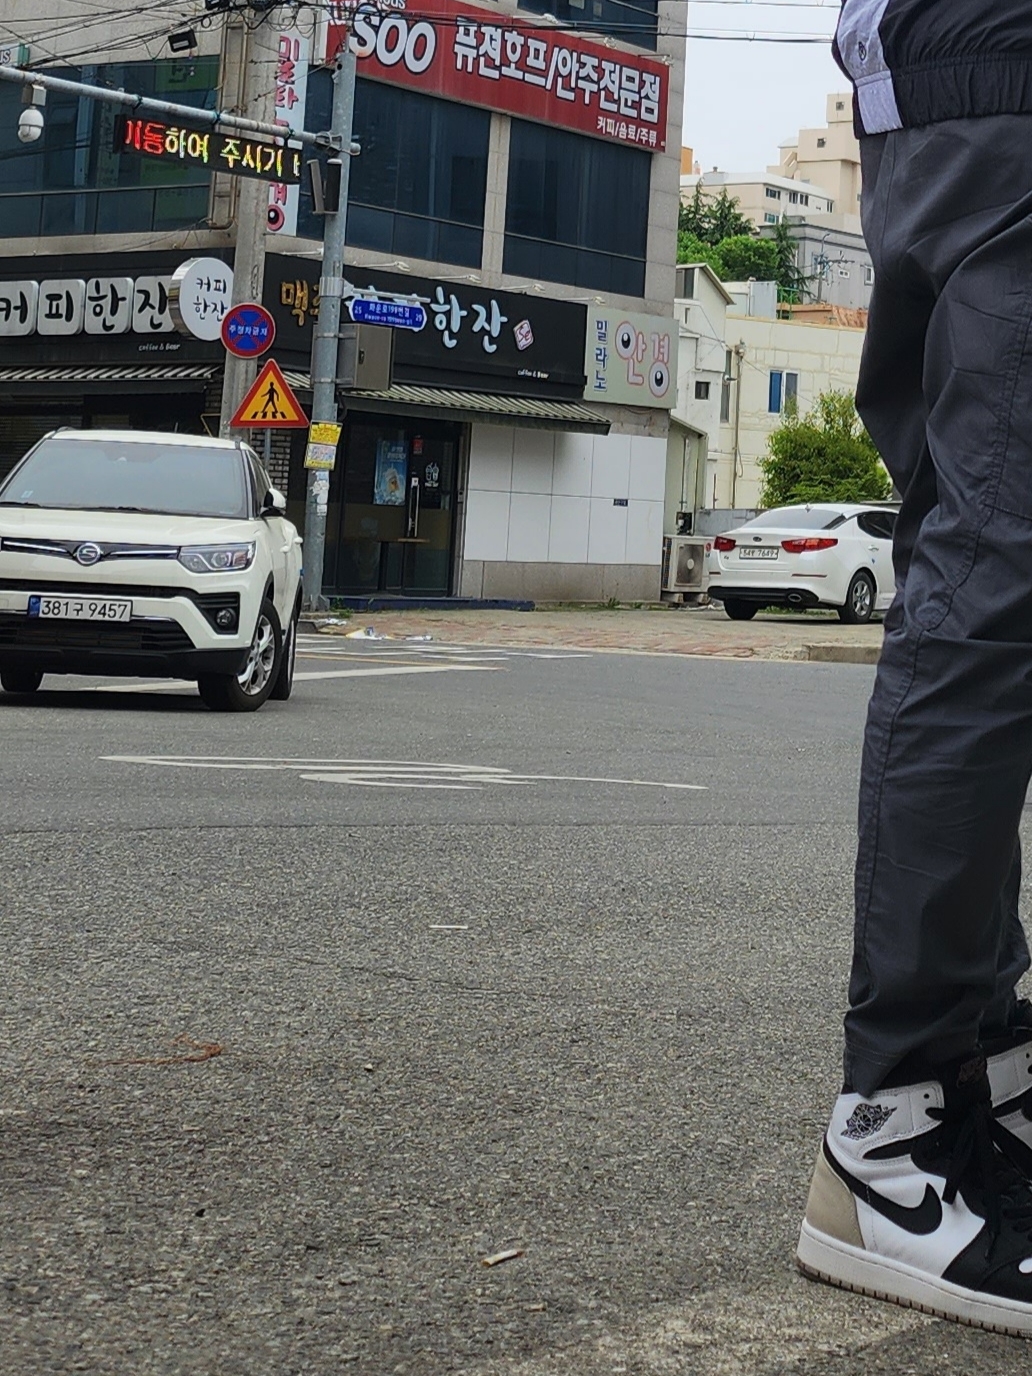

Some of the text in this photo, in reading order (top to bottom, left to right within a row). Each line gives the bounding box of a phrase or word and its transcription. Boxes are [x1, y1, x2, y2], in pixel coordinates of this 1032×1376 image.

[349, 2, 437, 74] SOO
[597, 115, 658, 147] 커피/음료/주류
[219, 138, 284, 178] 주시기
[196, 277, 227, 294] 커피
[0, 281, 171, 332] 커피한잔
[193, 295, 229, 322] 한잔
[229, 324, 268, 337] 주정차금지
[594, 320, 608, 392] 밀라노
[615, 321, 670, 398] 안경
[41, 598, 128, 619] 381구 9457
